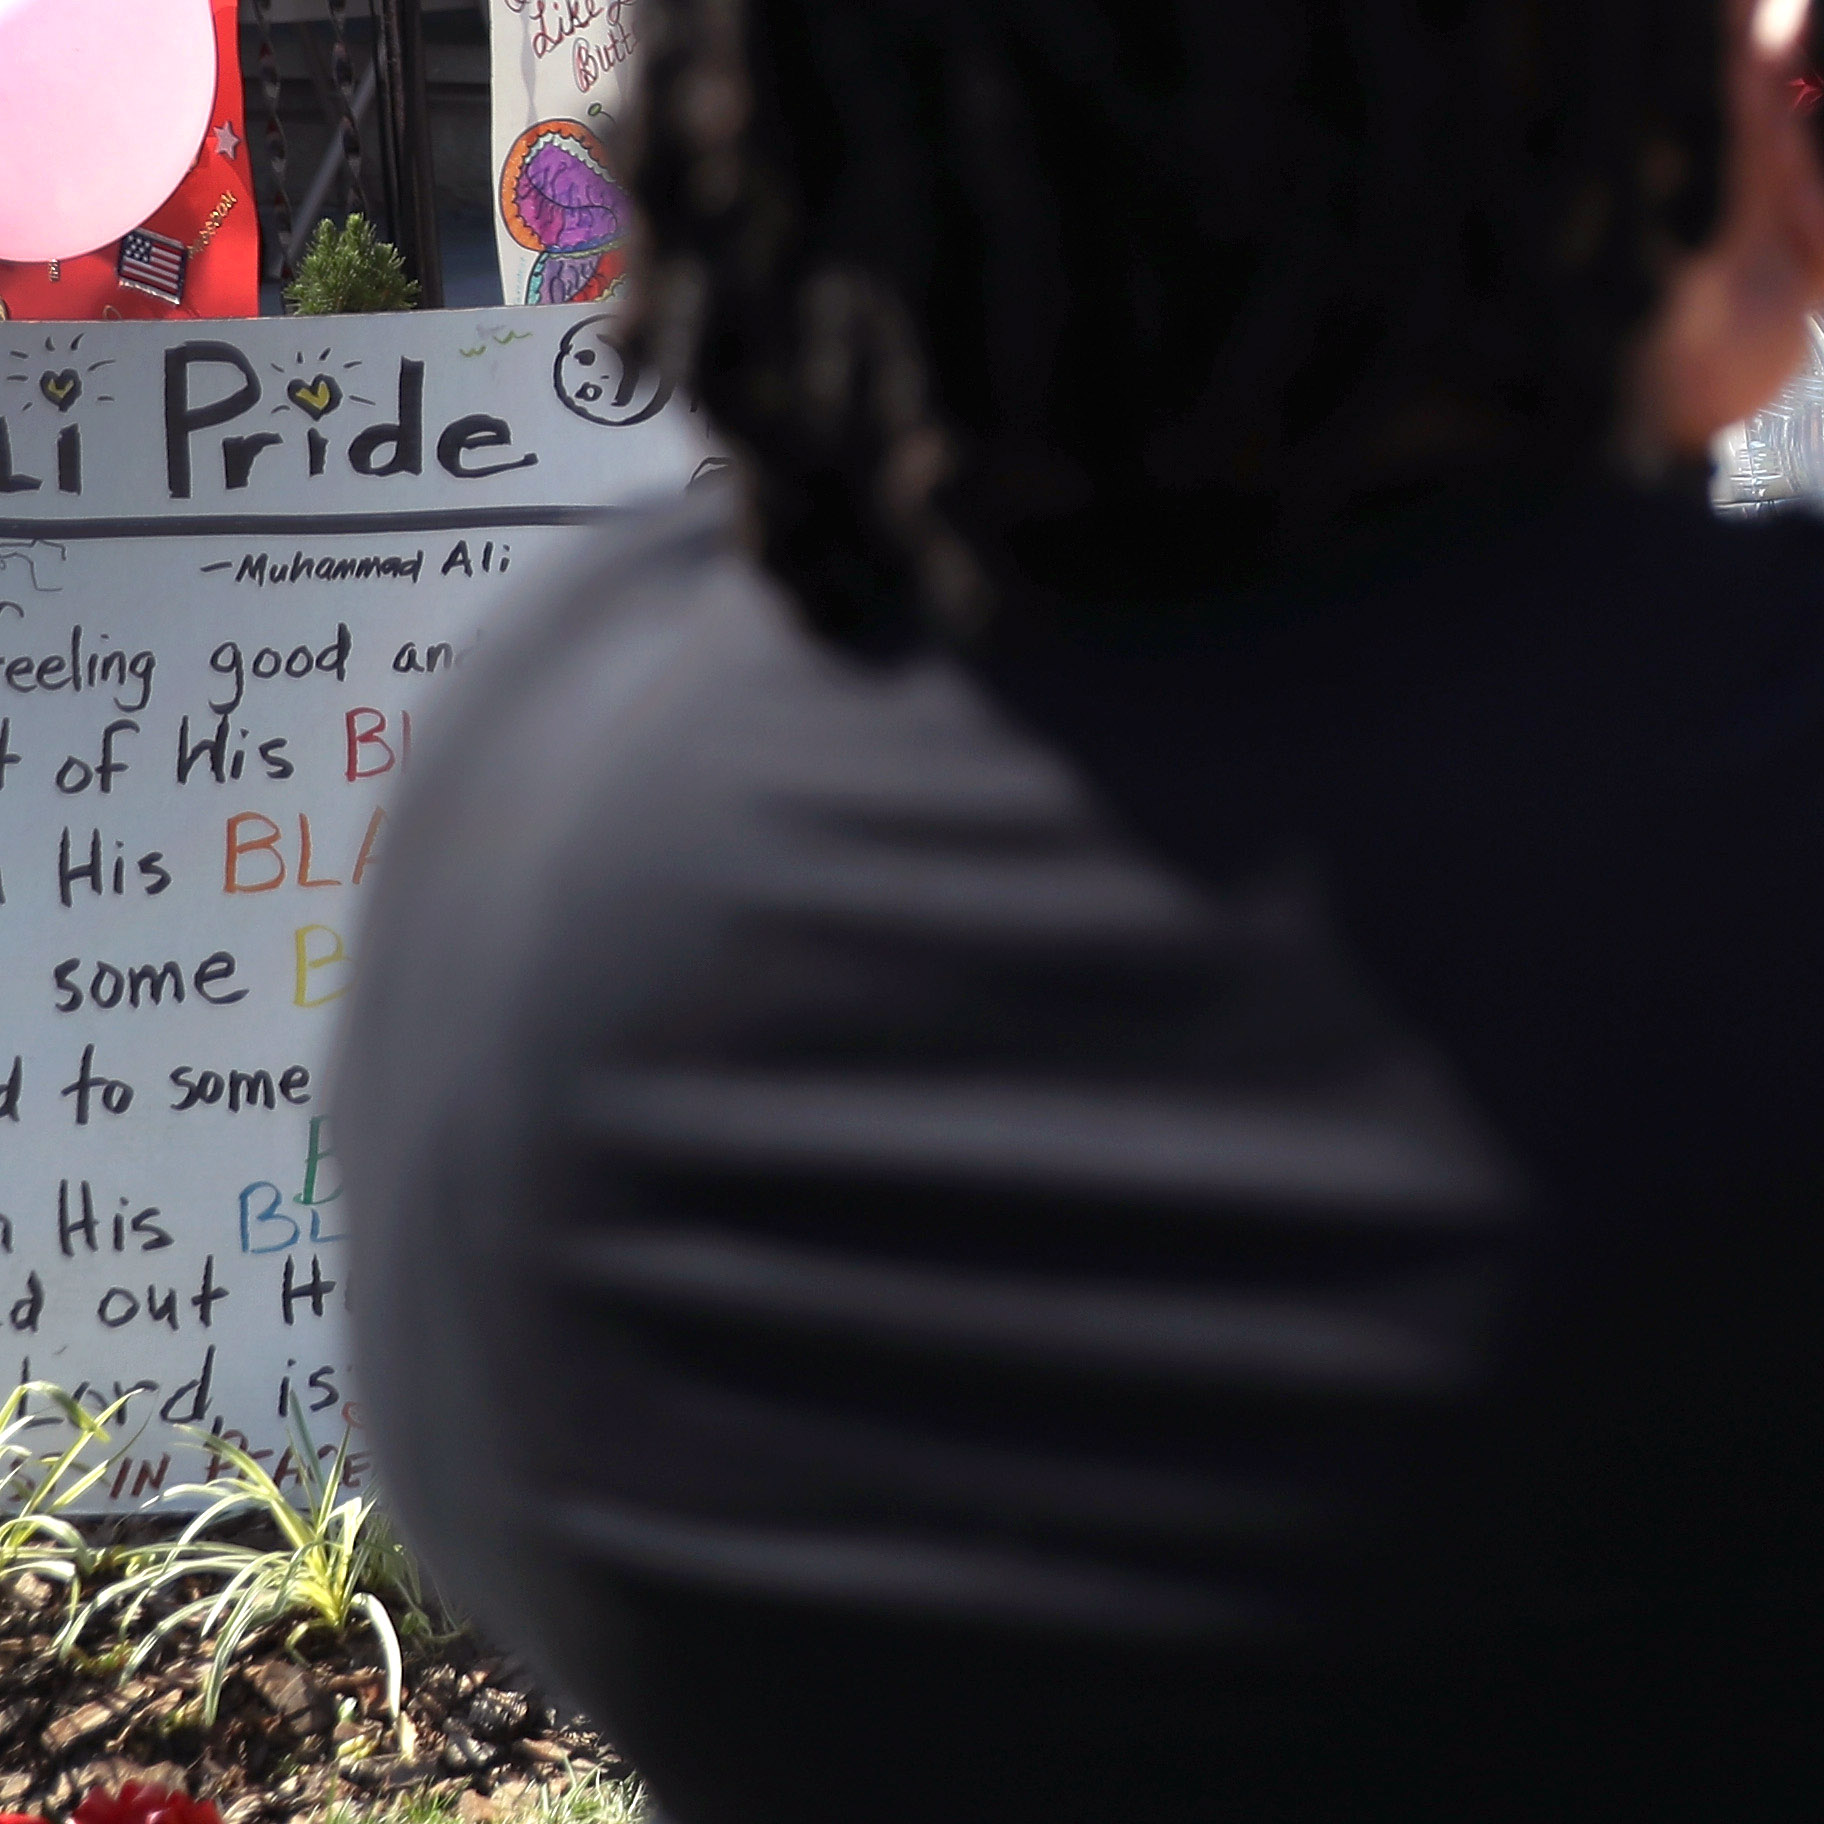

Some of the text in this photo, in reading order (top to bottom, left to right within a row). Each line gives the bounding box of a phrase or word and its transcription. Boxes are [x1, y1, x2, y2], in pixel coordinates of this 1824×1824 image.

[572, 21, 640, 94] Butt
[163, 339, 539, 499] Pride
[440, 538, 512, 577] Ali
[0, 616, 466, 716] eeling good an
[55, 718, 140, 795] of
[176, 710, 295, 785] His
[58, 824, 173, 909] His
[53, 950, 250, 1014] some
[61, 1043, 134, 1126] to
[170, 1064, 313, 1114] some
[58, 1177, 176, 1258] His
[98, 1253, 231, 1331] out
[278, 1358, 340, 1418] is
[109, 1452, 172, 1501] IN
